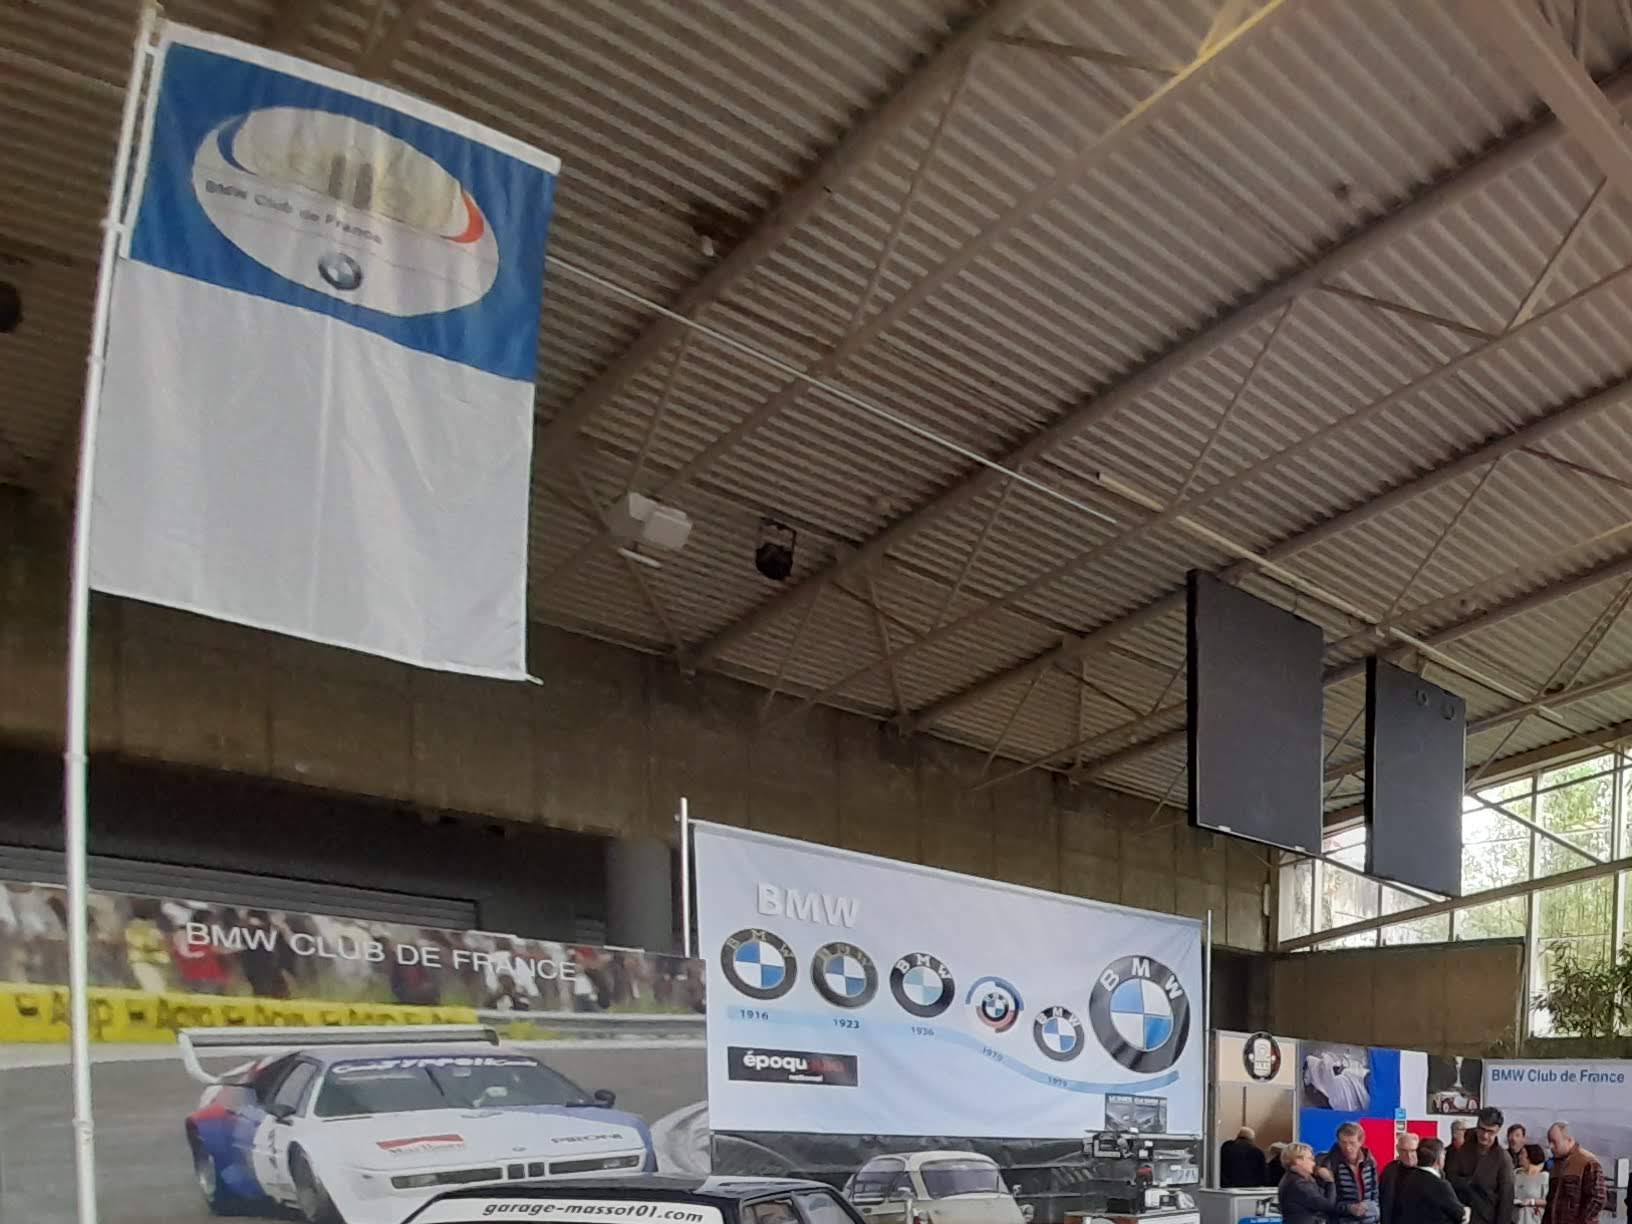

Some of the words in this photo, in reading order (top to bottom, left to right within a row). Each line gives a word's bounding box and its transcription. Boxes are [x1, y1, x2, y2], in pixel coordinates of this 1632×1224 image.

[756, 882, 864, 927] BMW
[185, 922, 278, 952] BMW
[290, 932, 386, 962] CLUB
[397, 944, 442, 968] DE
[452, 950, 578, 982] FRANCE
[896, 952, 952, 980] BMW
[1099, 957, 1184, 1001] BMW
[740, 1008, 769, 1021] 1916
[833, 1018, 860, 1029] 1923
[1491, 1068, 1525, 1082] BMW
[1527, 1067, 1558, 1083] Club
[1560, 1068, 1576, 1083] de
[1579, 1068, 1626, 1084] France
[483, 1203, 704, 1223] garage-massot01.com
